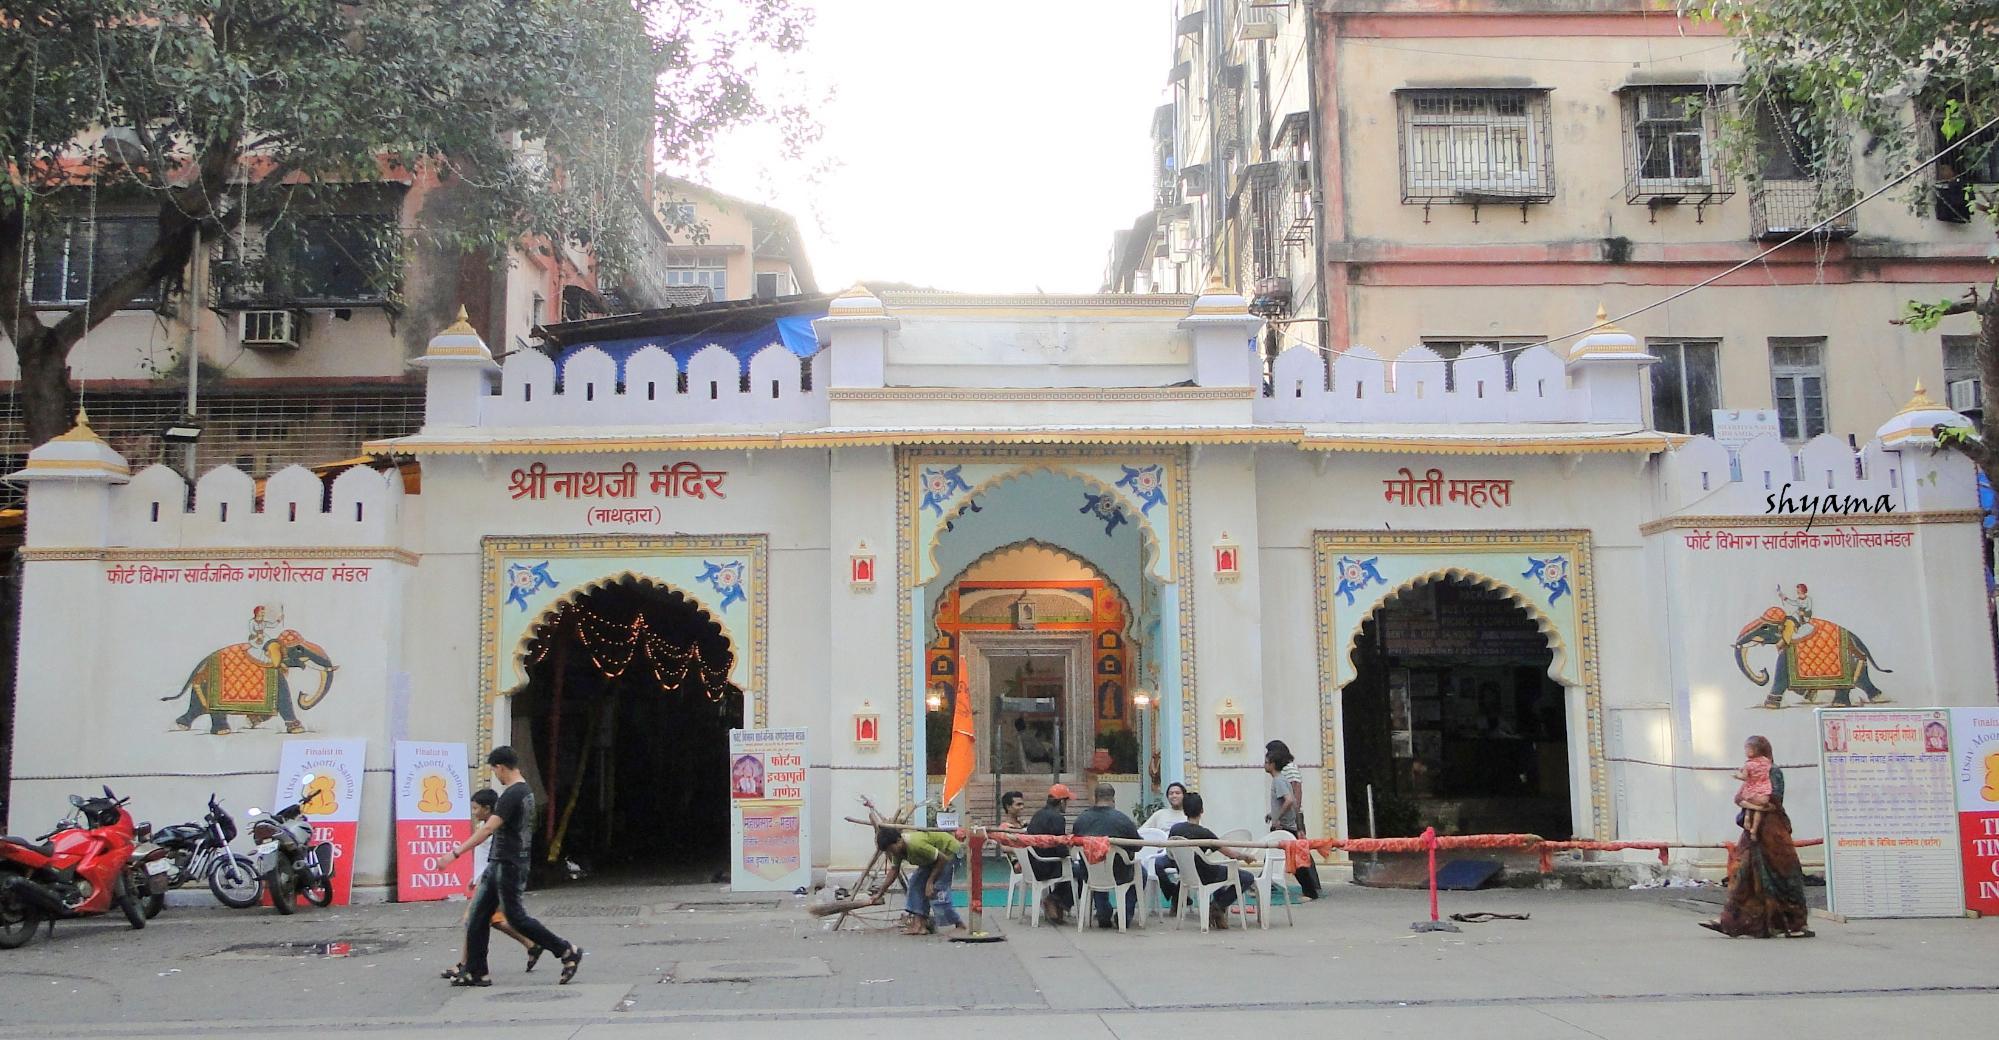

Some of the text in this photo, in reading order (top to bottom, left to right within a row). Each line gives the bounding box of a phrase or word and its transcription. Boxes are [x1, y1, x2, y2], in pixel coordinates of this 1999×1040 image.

[508, 461, 728, 500] श्रीनाथजी मंदिर
[1382, 467, 1514, 508] मोती महल
[1684, 527, 1914, 550] फोर्ट विभाग सार्वजनिक गणेशोत्सव मंडल
[107, 561, 372, 585] फोर्ट विभाग सार्वजनिक गणेशोत्सव मंडल
[305, 748, 343, 756] Finalist in
[415, 748, 449, 757] Finalist in
[301, 759, 336, 771] Moorti
[414, 761, 444, 770] Moorti
[773, 784, 800, 798] गणेश
[416, 825, 453, 839] THE
[411, 872, 461, 888] INDIA
